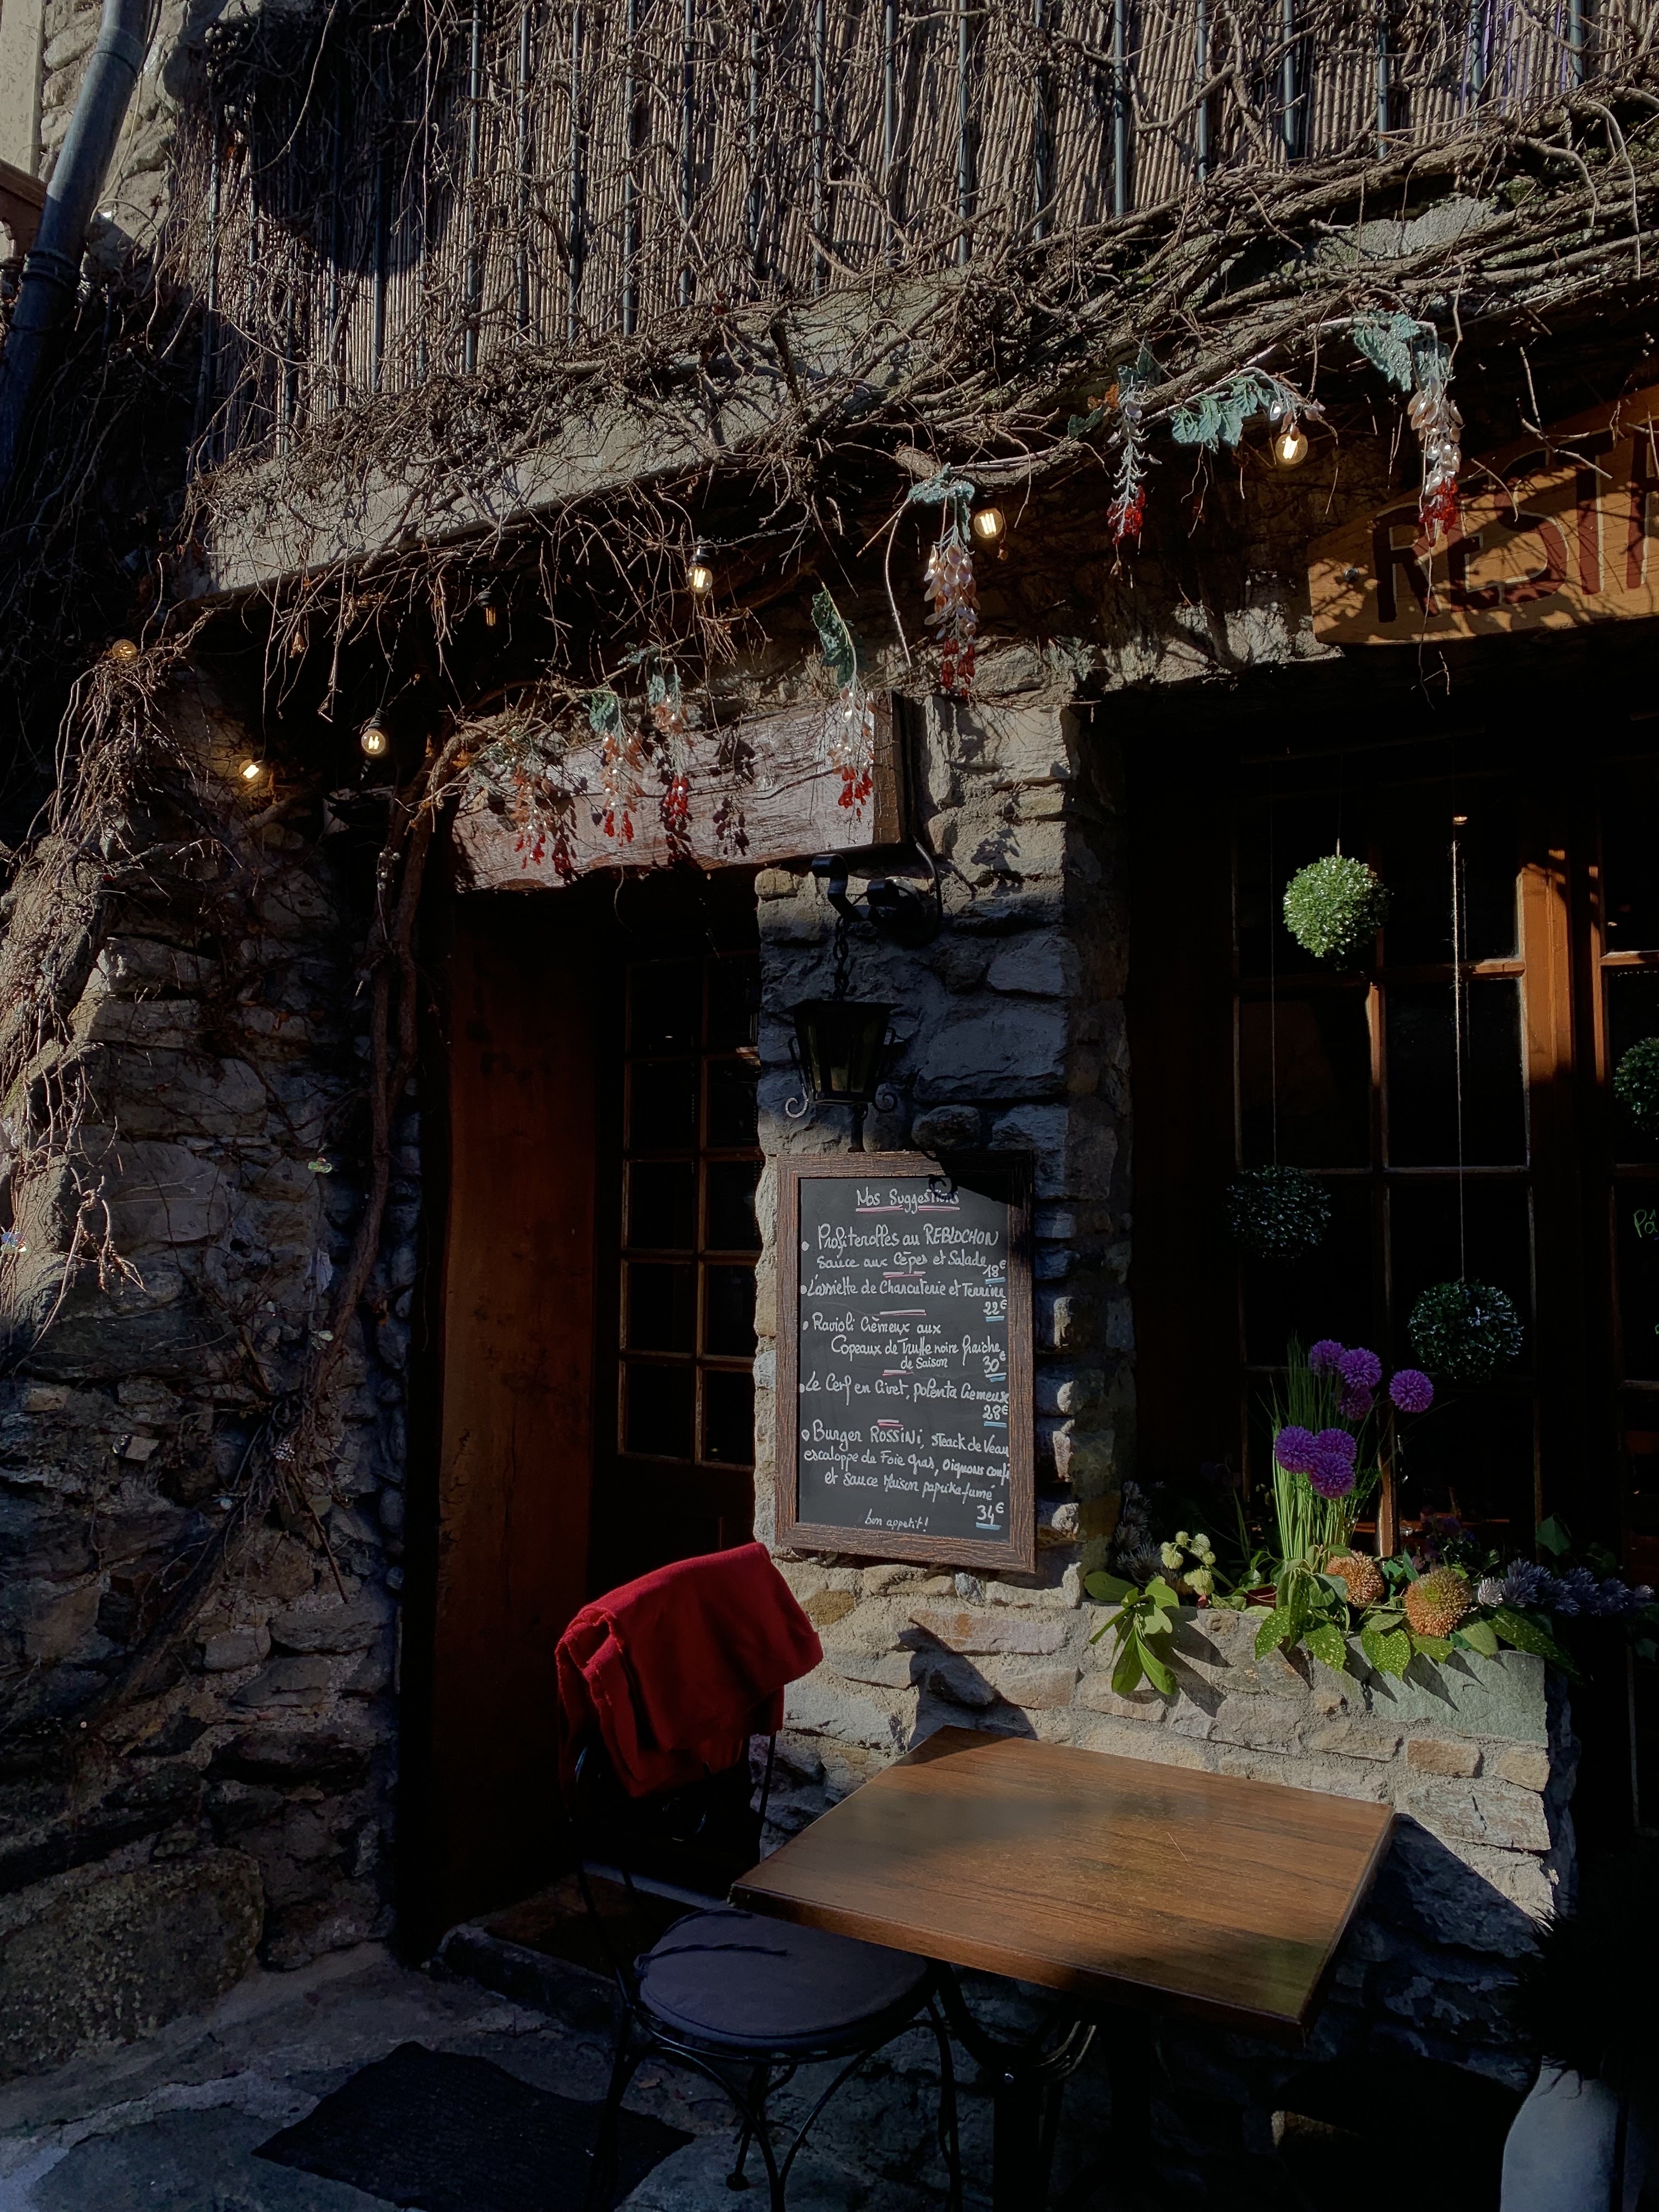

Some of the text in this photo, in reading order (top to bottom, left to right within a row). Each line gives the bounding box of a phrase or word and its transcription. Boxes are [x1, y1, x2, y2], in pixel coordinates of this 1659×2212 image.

[856, 1187, 881, 1206] Nos
[818, 1223, 999, 1259] Profiterolles au REBLOCHON
[864, 1258, 888, 1267] aux
[933, 1249, 946, 1265] et
[948, 1249, 987, 1267] Salade
[983, 1260, 1007, 1278] 18€
[861, 1278, 877, 1294] de
[949, 1279, 961, 1296] et
[983, 1299, 1007, 1316] 22€
[812, 1312, 855, 1332] Ravioli
[917, 1324, 941, 1334] aux
[831, 1334, 882, 1362] Copeaux
[885, 1339, 898, 1355] de
[897, 1336, 933, 1356] Truffe
[934, 1342, 960, 1353] noire
[900, 1356, 913, 1369] de
[983, 1350, 1006, 1374] 30€
[806, 1371, 821, 1391] Le
[826, 1373, 851, 1406] Cerf
[854, 1383, 871, 1394] en
[982, 1404, 1008, 1420] 28€
[812, 1419, 863, 1452] Burger
[968, 1436, 982, 1452] de
[984, 1434, 1009, 1457] Veau
[804, 1445, 859, 1472] escaloppe
[861, 1448, 877, 1464] de
[881, 1450, 905, 1466] Foie
[825, 1466, 838, 1485] et
[884, 1473, 919, 1492] Maison
[865, 1508, 882, 1526] bon
[977, 1502, 1005, 1525] 34€
